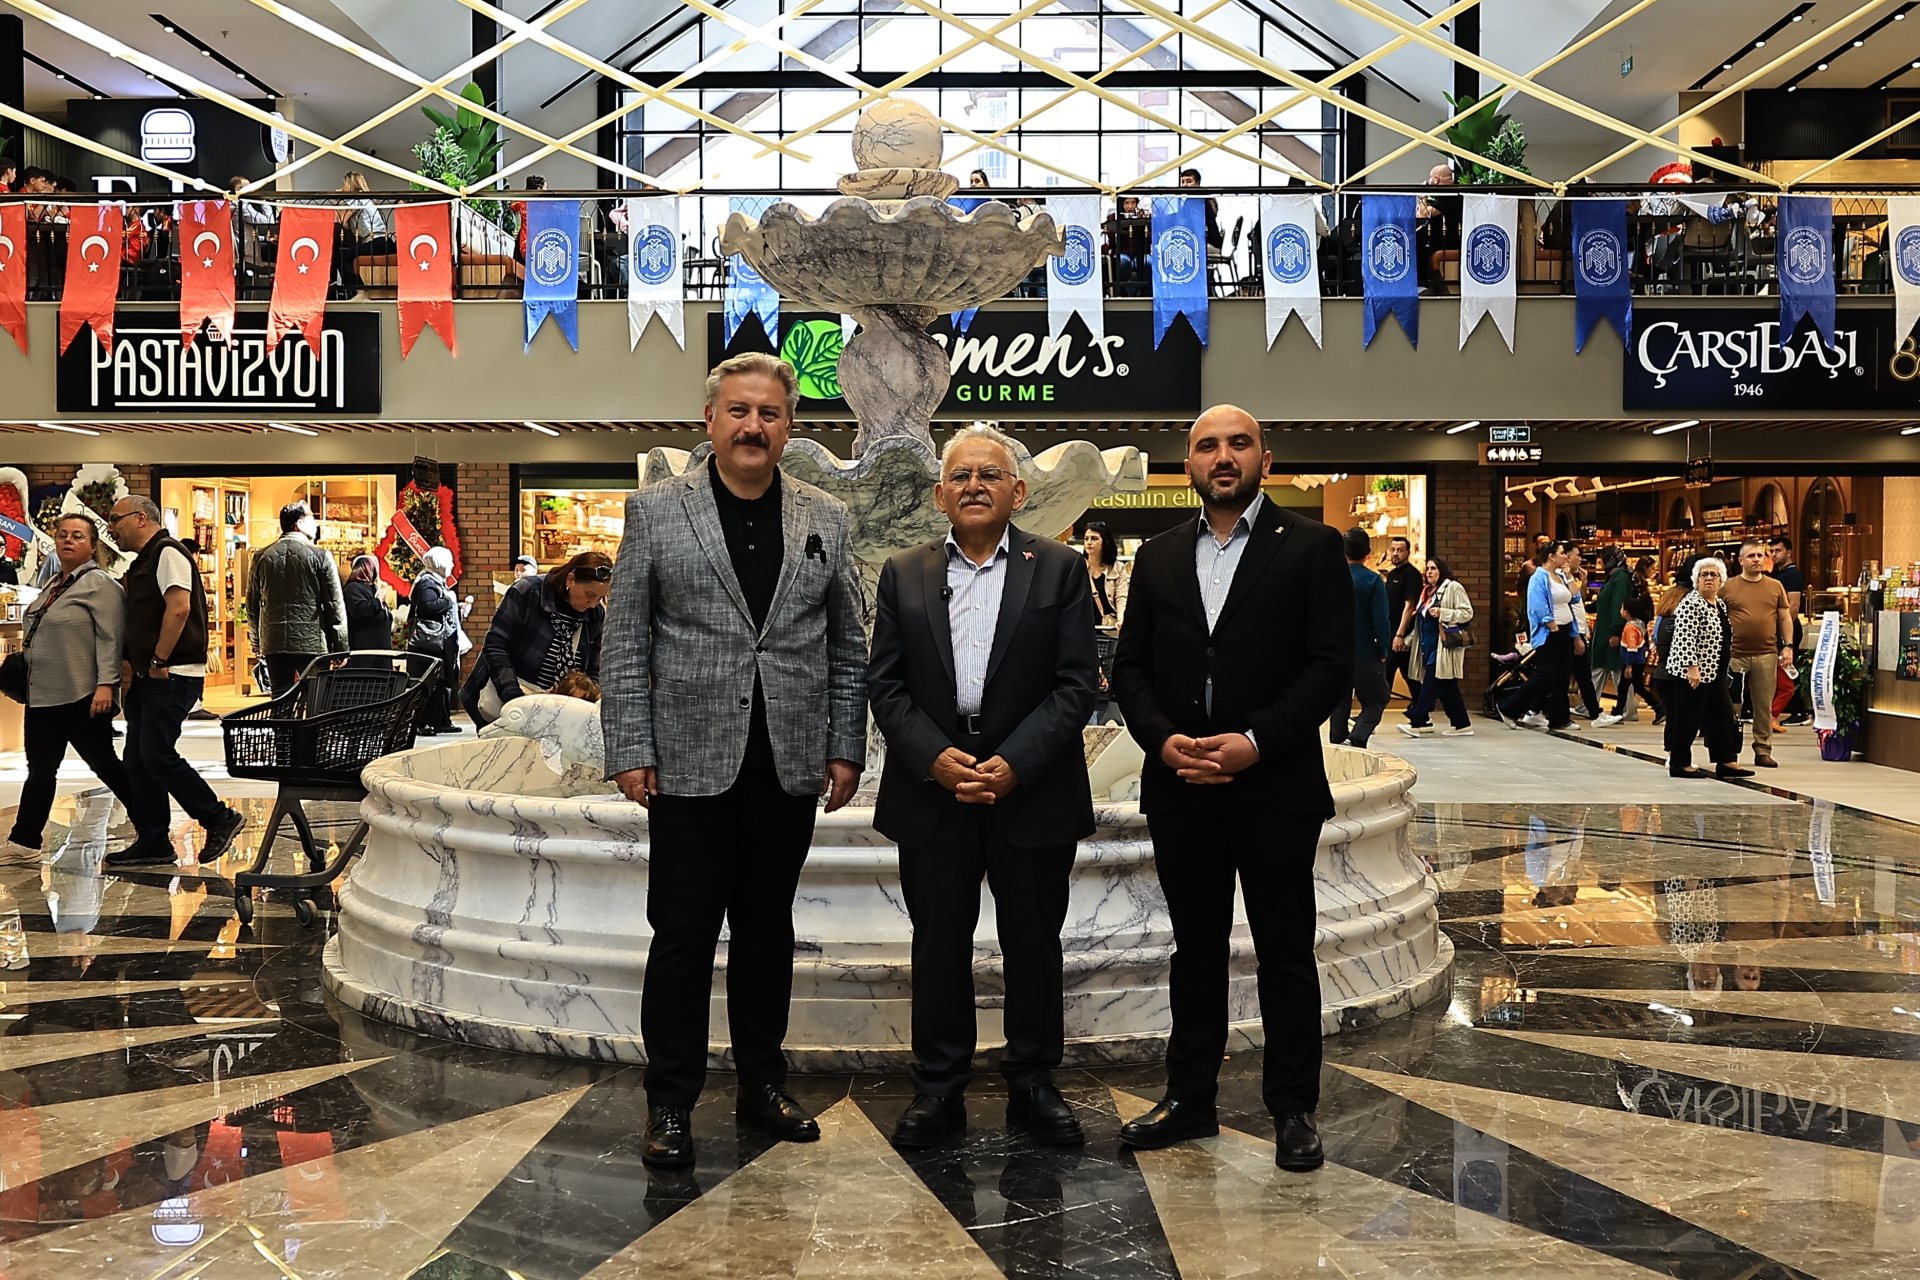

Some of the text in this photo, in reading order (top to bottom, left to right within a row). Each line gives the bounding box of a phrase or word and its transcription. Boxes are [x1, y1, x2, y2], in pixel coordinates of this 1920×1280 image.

[1638, 322, 1858, 389] ÇARŞIBAŞI
[91, 329, 344, 408] PASTAVİZYON
[956, 384, 1055, 401] GURME
[1733, 383, 1763, 396] 1946
[1530, 448, 1542, 456] WC
